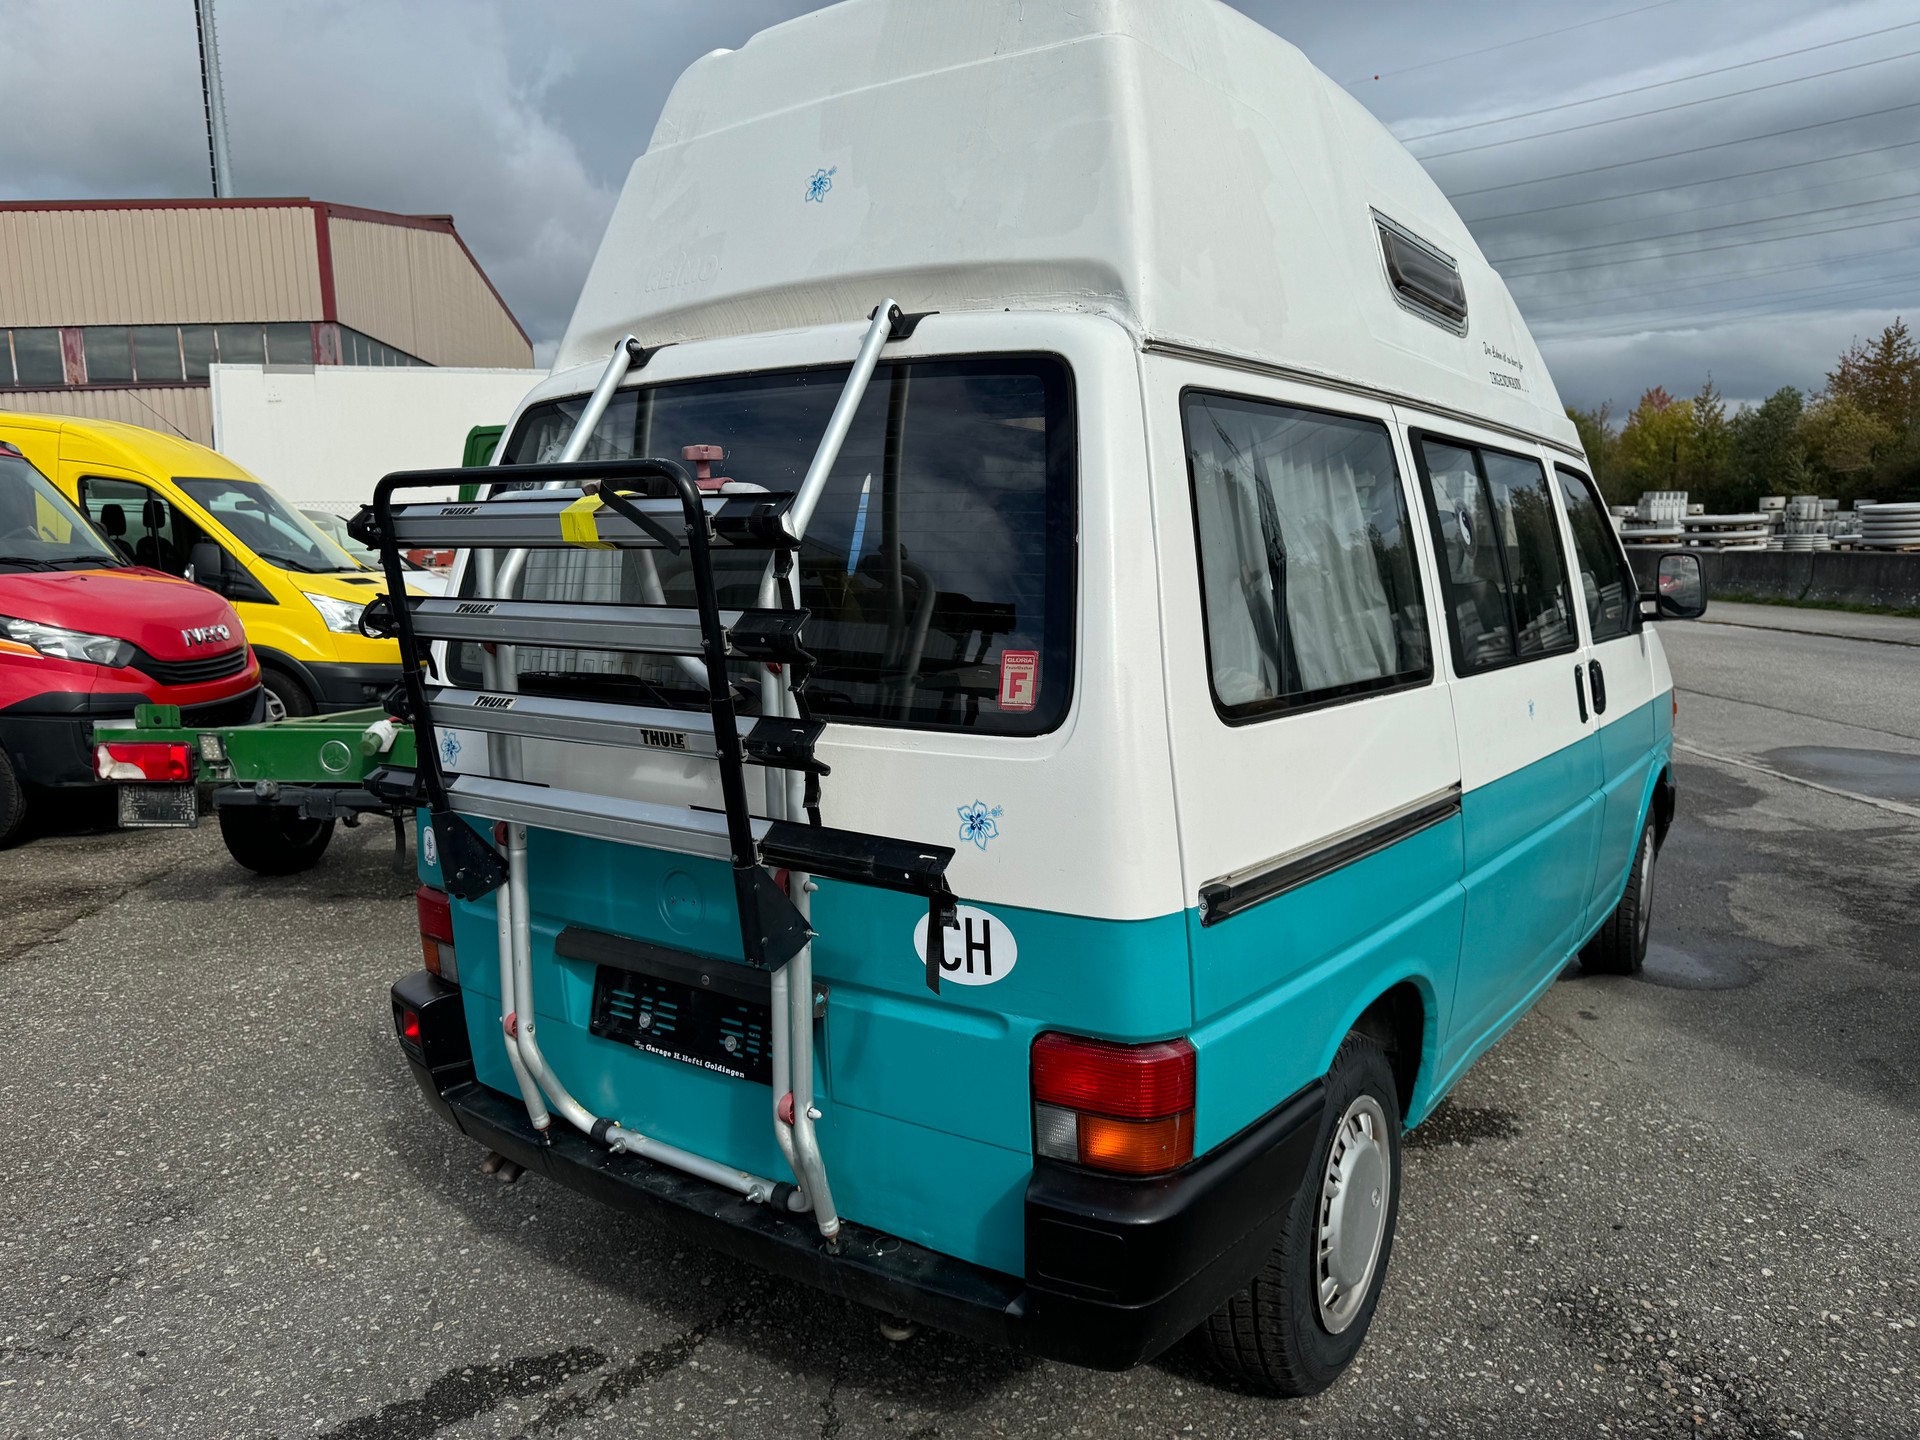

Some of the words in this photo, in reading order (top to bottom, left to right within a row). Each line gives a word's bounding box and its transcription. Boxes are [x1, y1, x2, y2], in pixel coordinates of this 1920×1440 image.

[455, 603, 495, 614] THULE
[181, 624, 230, 647] IVECO
[1008, 672, 1028, 699] F
[474, 696, 513, 709] THULE
[641, 729, 687, 749] THULE
[939, 917, 992, 976] CH
[645, 1044, 672, 1058] Garage
[704, 1061, 745, 1078] Goldingen
